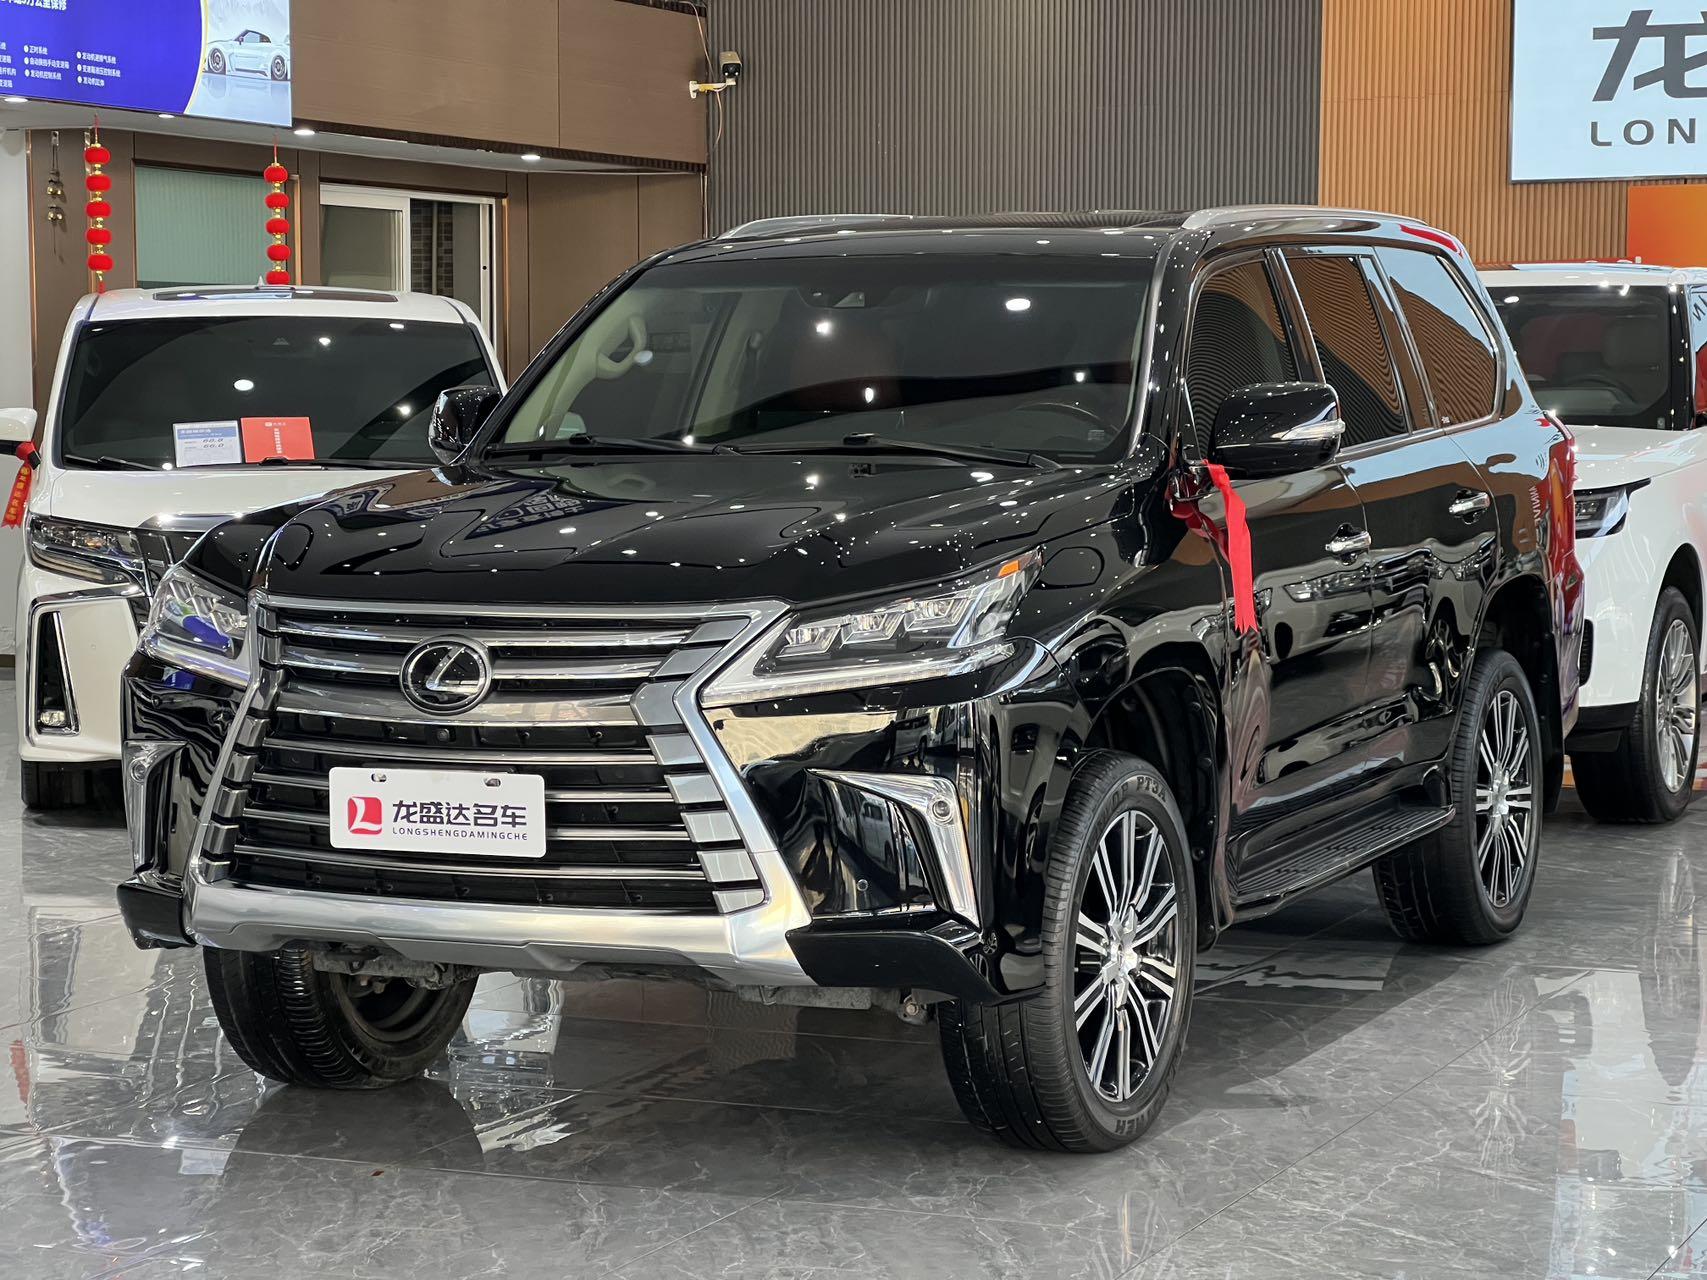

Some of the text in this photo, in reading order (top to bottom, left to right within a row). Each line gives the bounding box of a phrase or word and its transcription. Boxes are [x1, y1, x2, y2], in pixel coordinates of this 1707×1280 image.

[1590, 118, 1696, 147] LON
[392, 800, 528, 829] 龙盛达名车
[392, 827, 528, 841] LONGSHENGDAMINGCHE
